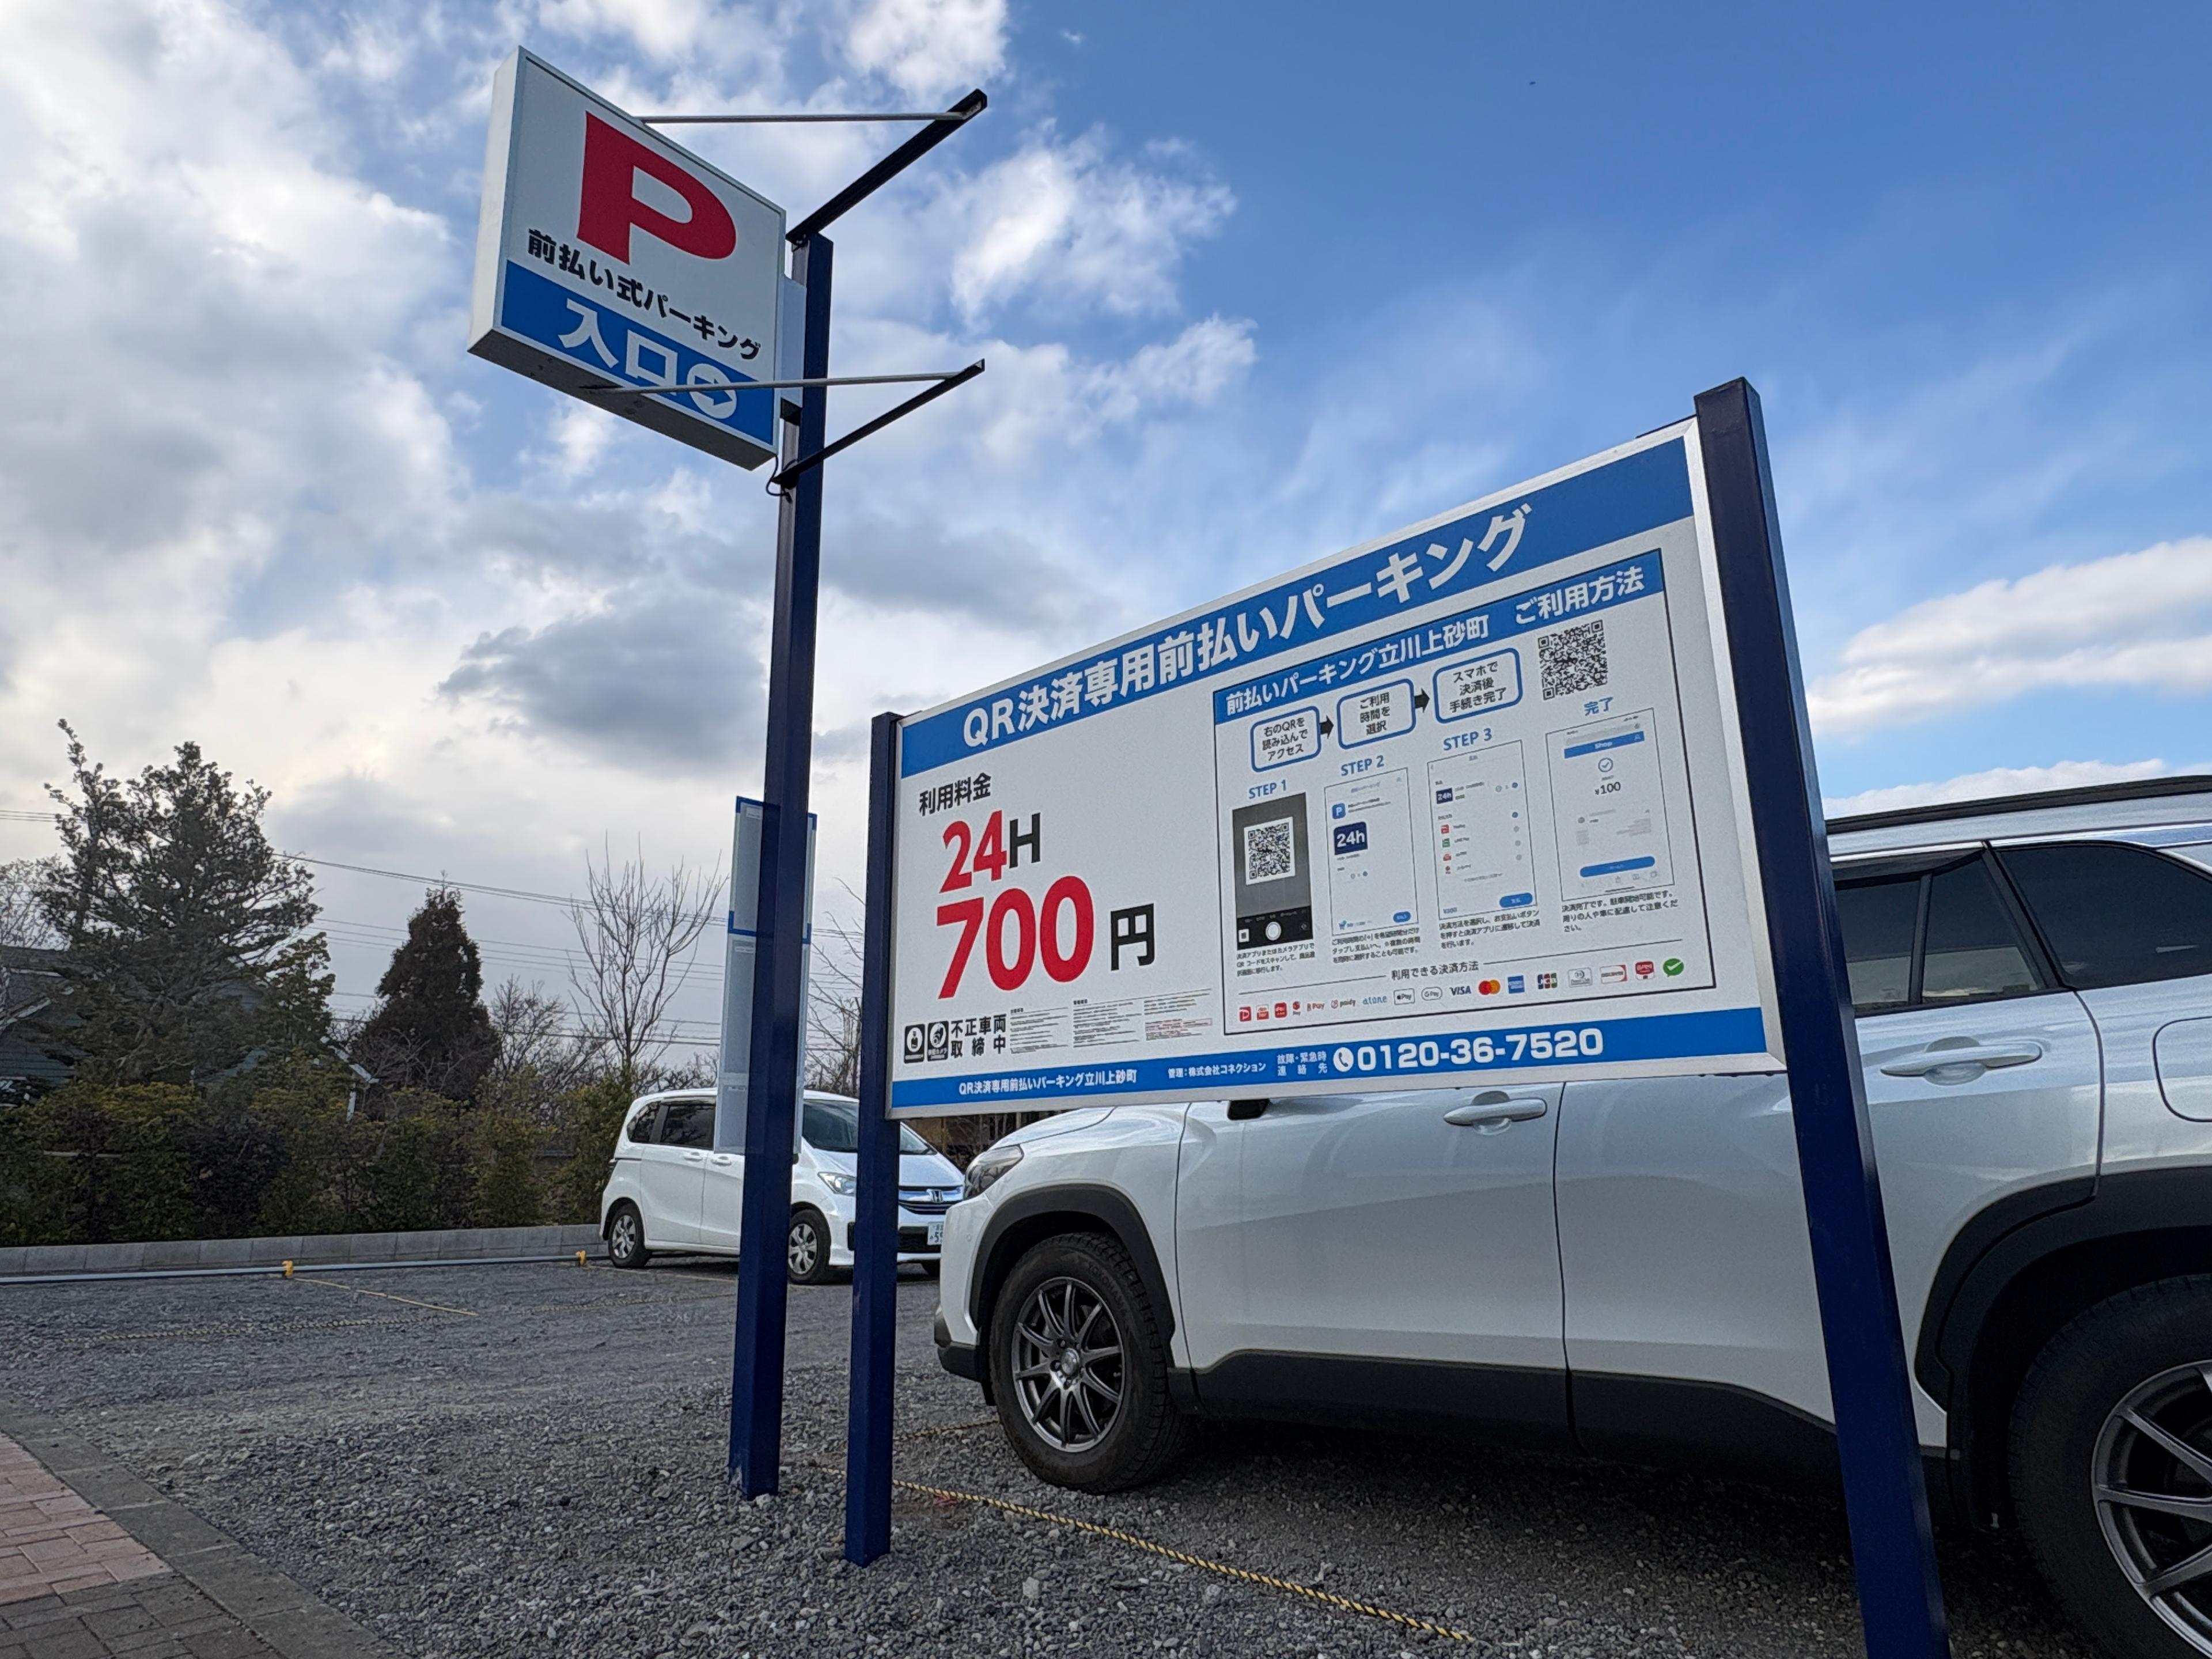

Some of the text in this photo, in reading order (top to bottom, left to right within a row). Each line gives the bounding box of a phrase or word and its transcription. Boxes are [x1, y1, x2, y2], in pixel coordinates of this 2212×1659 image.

[577, 110, 737, 265] P
[528, 229, 761, 360] 前払い式パーキング
[559, 298, 679, 396] 入口
[963, 502, 1532, 747] QR決済専用前払いパーキング
[1226, 566, 1645, 715] 前払いパーキング立川上砂町 ご利用方法
[1453, 661, 1498, 684] スマホで
[1459, 677, 1494, 696] 決済後
[1360, 692, 1389, 709] ご利用
[1449, 687, 1506, 713] 手続き完了
[1584, 696, 1613, 716] 完了
[1360, 706, 1390, 723] 時間を
[1263, 717, 1304, 737] 右のQRを
[1366, 720, 1387, 735] 選択
[1262, 729, 1308, 751] 読み込んで
[1442, 728, 1493, 751] STEP 3
[1267, 743, 1304, 761] アクセス
[1340, 755, 1384, 777] STEP 2
[919, 772, 991, 815] 利用料金
[1248, 779, 1287, 800] STEP 1
[1336, 830, 1365, 848] 24h
[1391, 961, 1479, 980] 利用できる決済方法
[1449, 986, 1471, 996] VISA
[951, 1013, 1006, 1038] 不正車両
[1357, 1028, 1604, 1071] 0120-36-7520
[959, 1069, 1138, 1095] QR決済専用前払いパーキング立川上砂町
